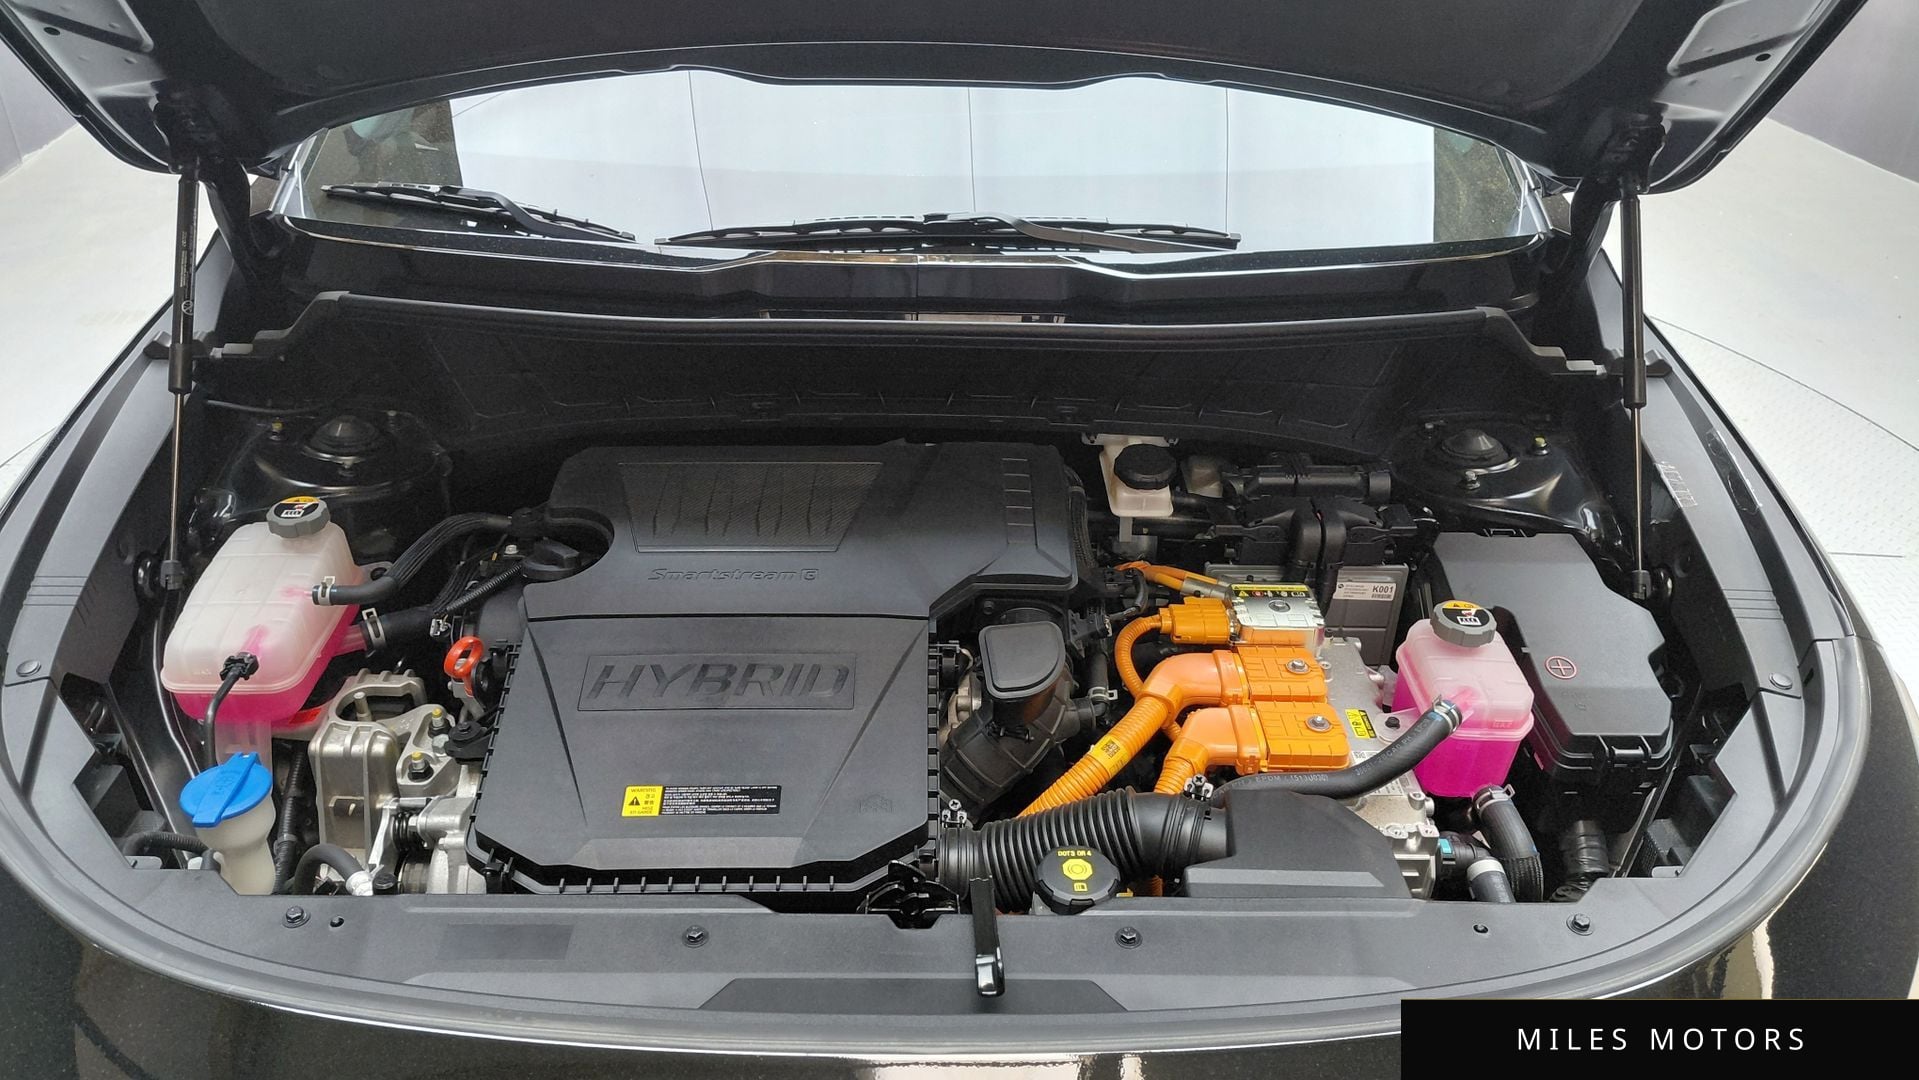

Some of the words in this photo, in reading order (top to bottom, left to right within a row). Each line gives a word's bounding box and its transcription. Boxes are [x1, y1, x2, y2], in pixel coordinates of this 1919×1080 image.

[647, 568, 797, 581] Smartstream
[1372, 585, 1394, 593] K001
[586, 663, 850, 698] HYBRID
